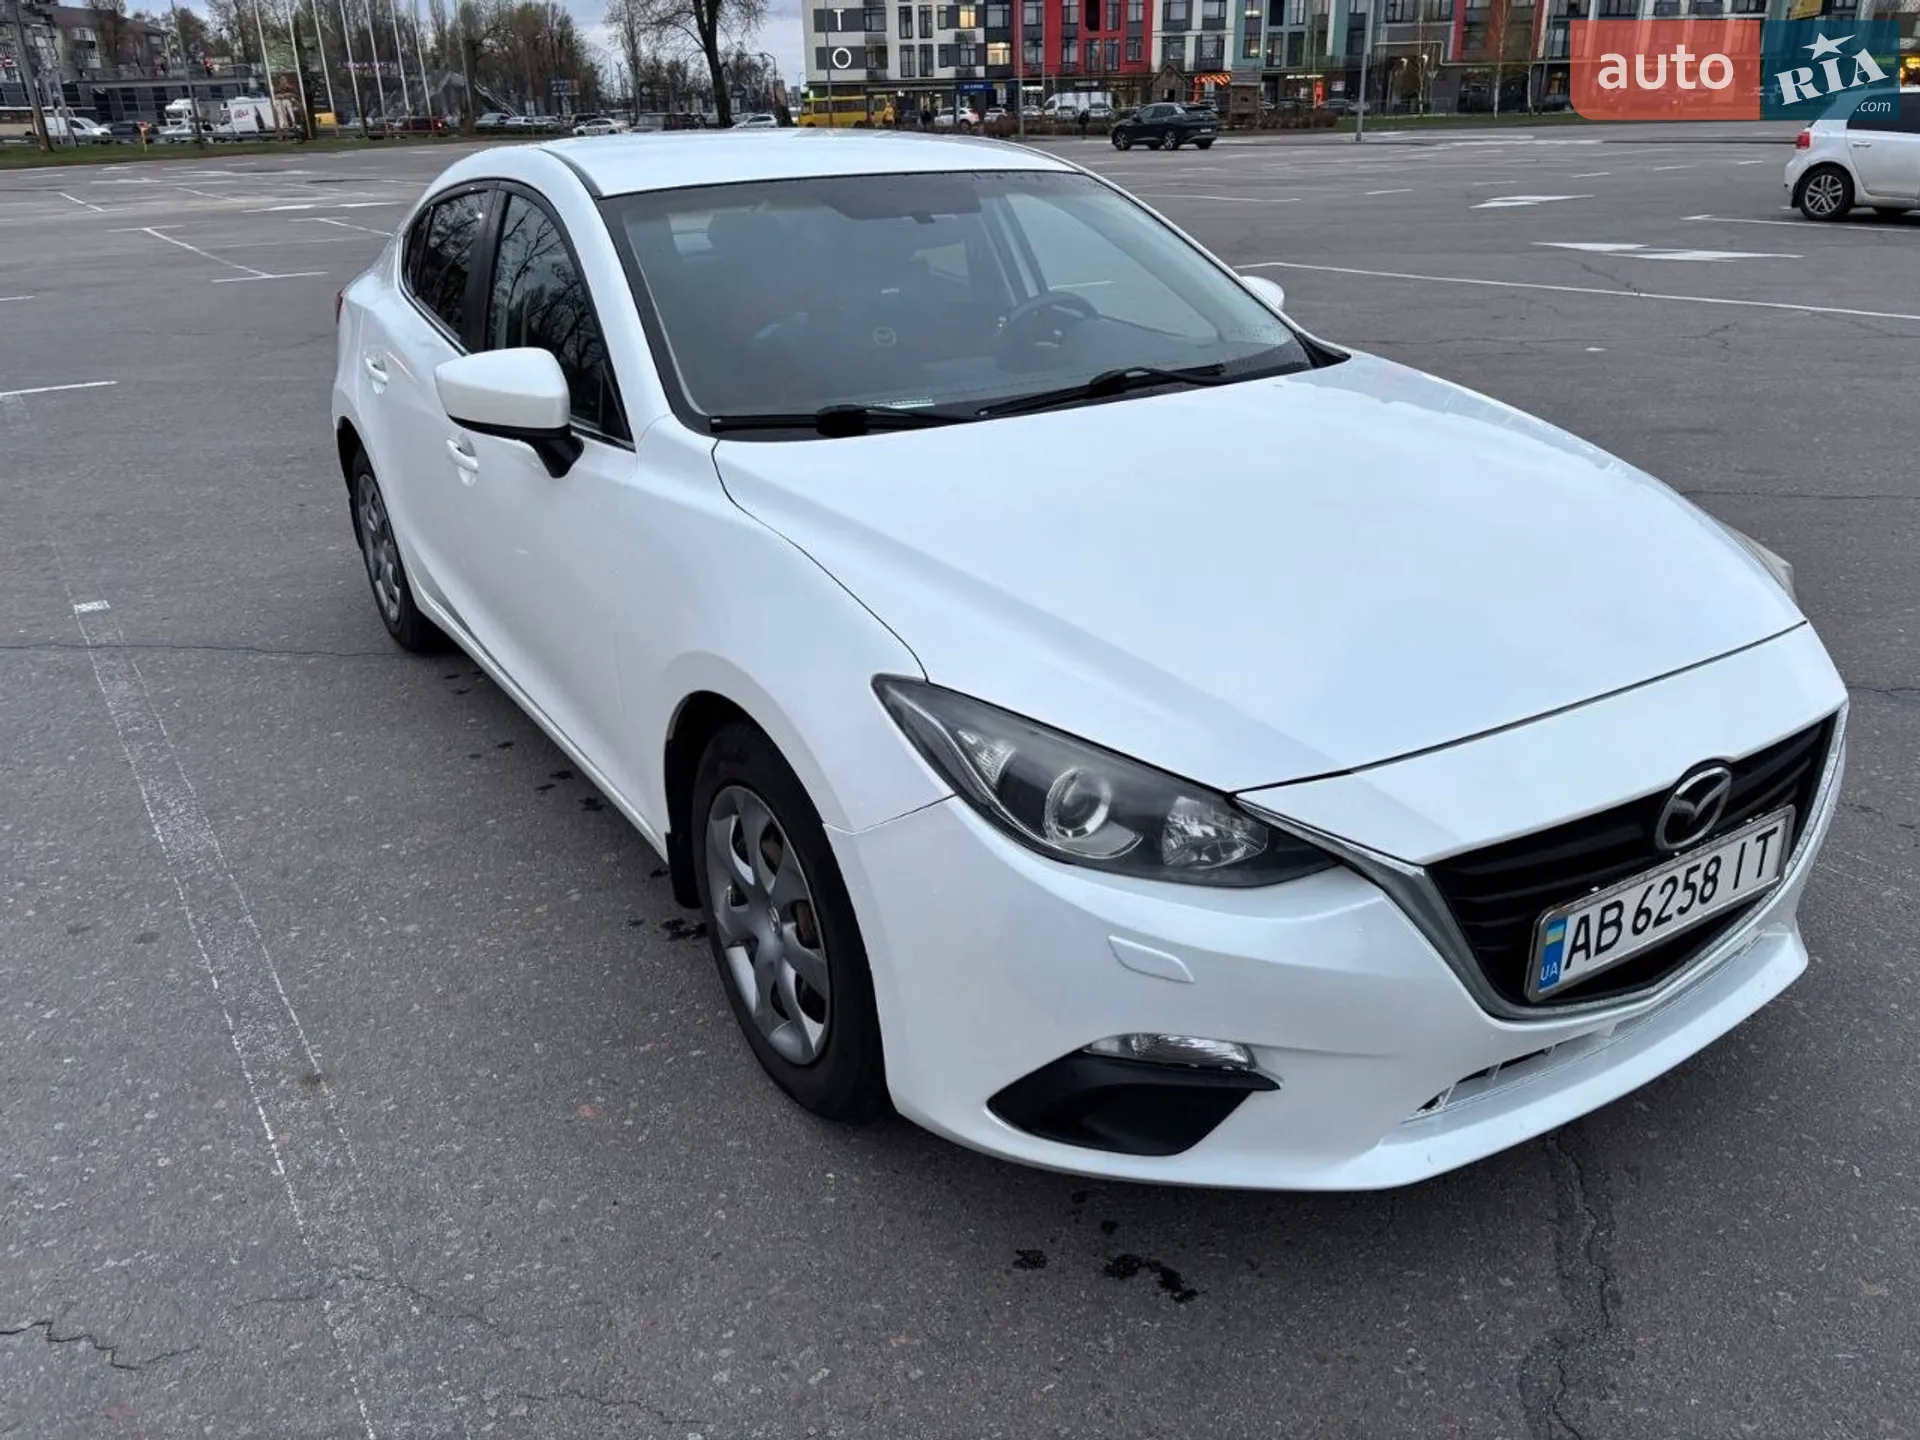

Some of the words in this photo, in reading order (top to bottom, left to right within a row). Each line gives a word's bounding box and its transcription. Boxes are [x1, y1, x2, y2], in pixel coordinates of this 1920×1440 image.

[1564, 900, 1624, 971] AB
[1631, 855, 1721, 936] 6258
[1732, 826, 1778, 891] IT
[1540, 961, 1559, 981] UA
